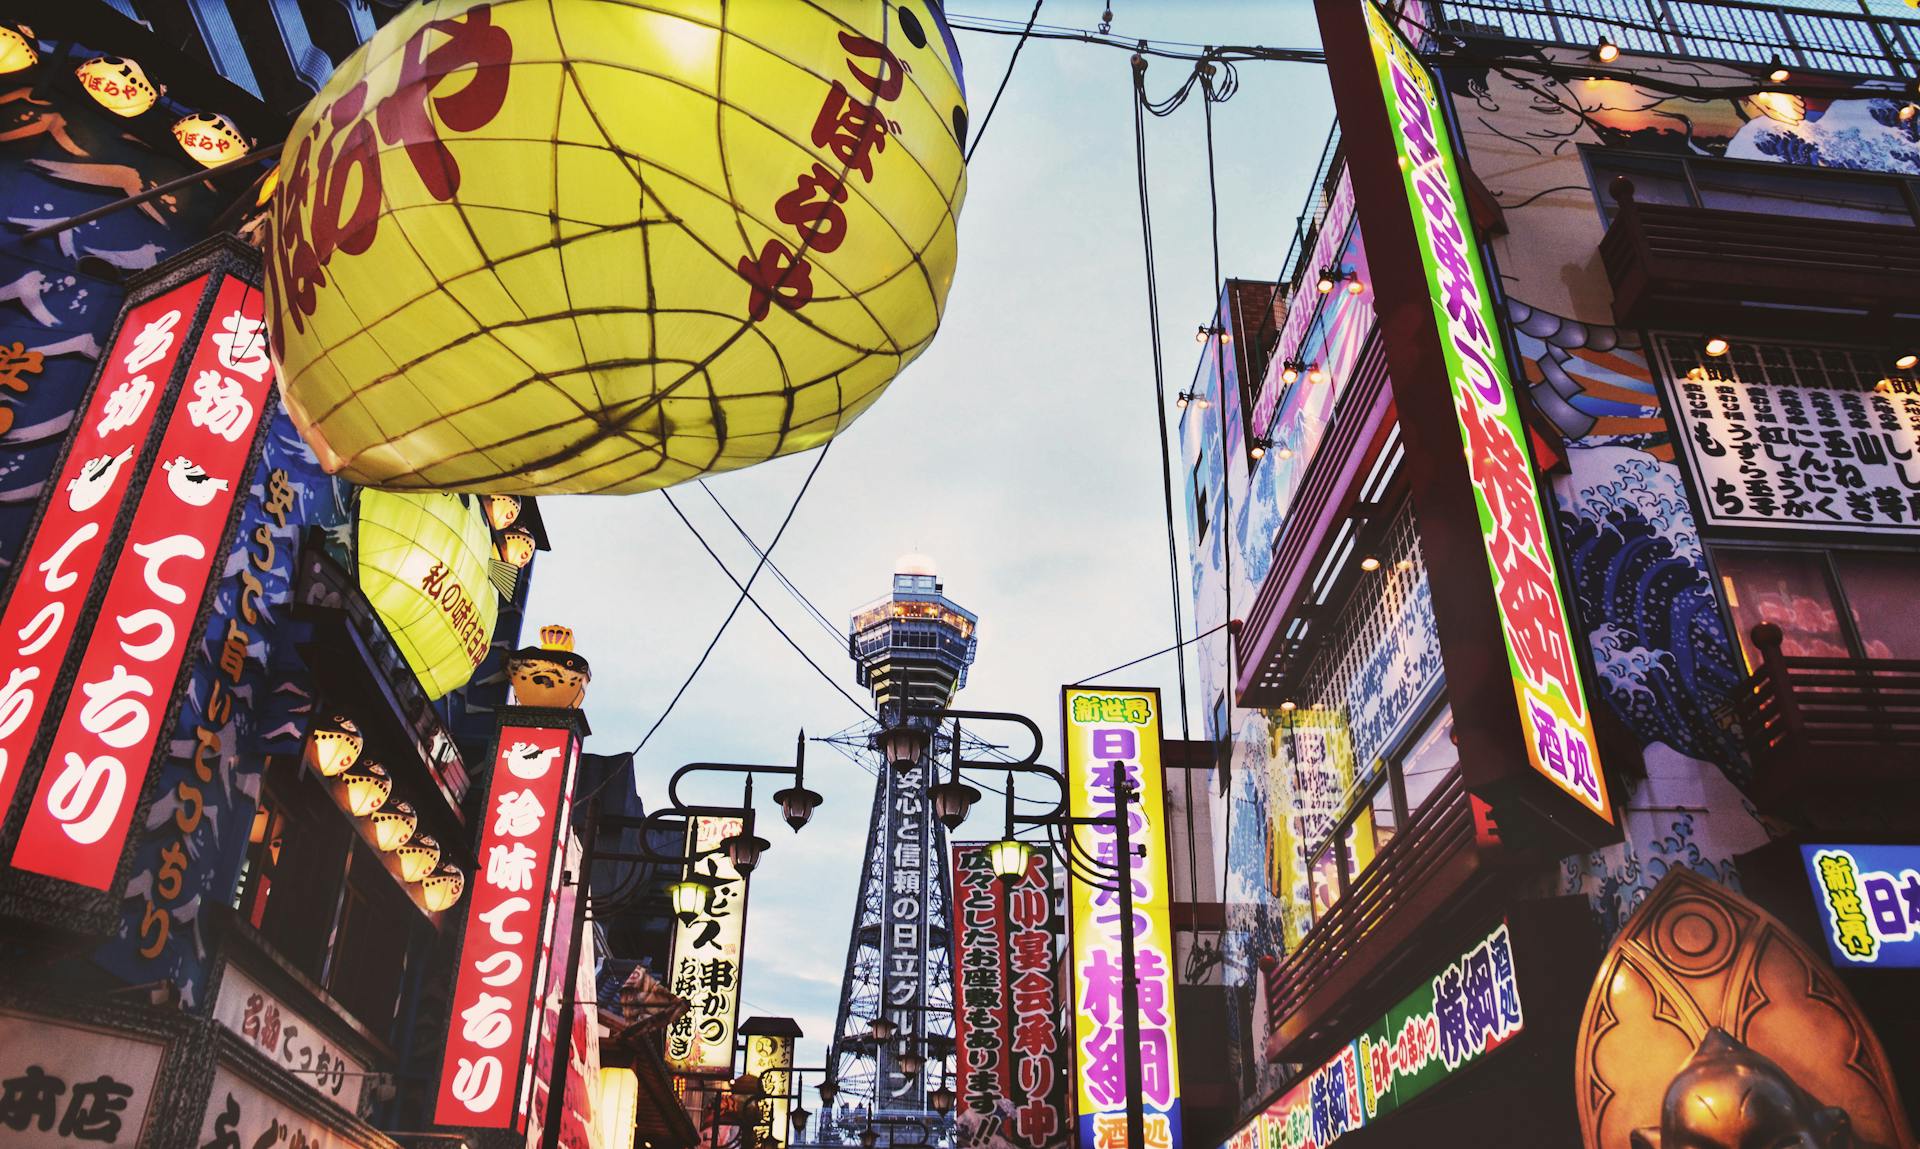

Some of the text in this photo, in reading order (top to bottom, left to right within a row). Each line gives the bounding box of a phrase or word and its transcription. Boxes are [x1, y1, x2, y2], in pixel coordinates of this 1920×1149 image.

[738, 30, 912, 321] づぼらや
[1391, 61, 1501, 404] 日本一の串かつ
[1694, 422, 1743, 514] もち
[1727, 424, 1780, 516] うずら玉子
[1755, 425, 1813, 518] 紅しょうが
[1788, 428, 1841, 520] にんにく
[1820, 430, 1873, 521] 玉ねぎ
[1852, 432, 1908, 522] 山芋
[1457, 382, 1583, 720] 横綱
[1073, 696, 1151, 724] 新世界
[1529, 697, 1598, 802] 酒処
[1818, 855, 1874, 957] 新世界
[699, 957, 734, 1042] 串かつ
[1436, 946, 1499, 1066] 横綱
[1491, 931, 1519, 1028] 酒処
[1083, 948, 1171, 1106] 横綱
[1097, 1117, 1169, 1149] 酒処
[1311, 1060, 1349, 1147] 横綱
